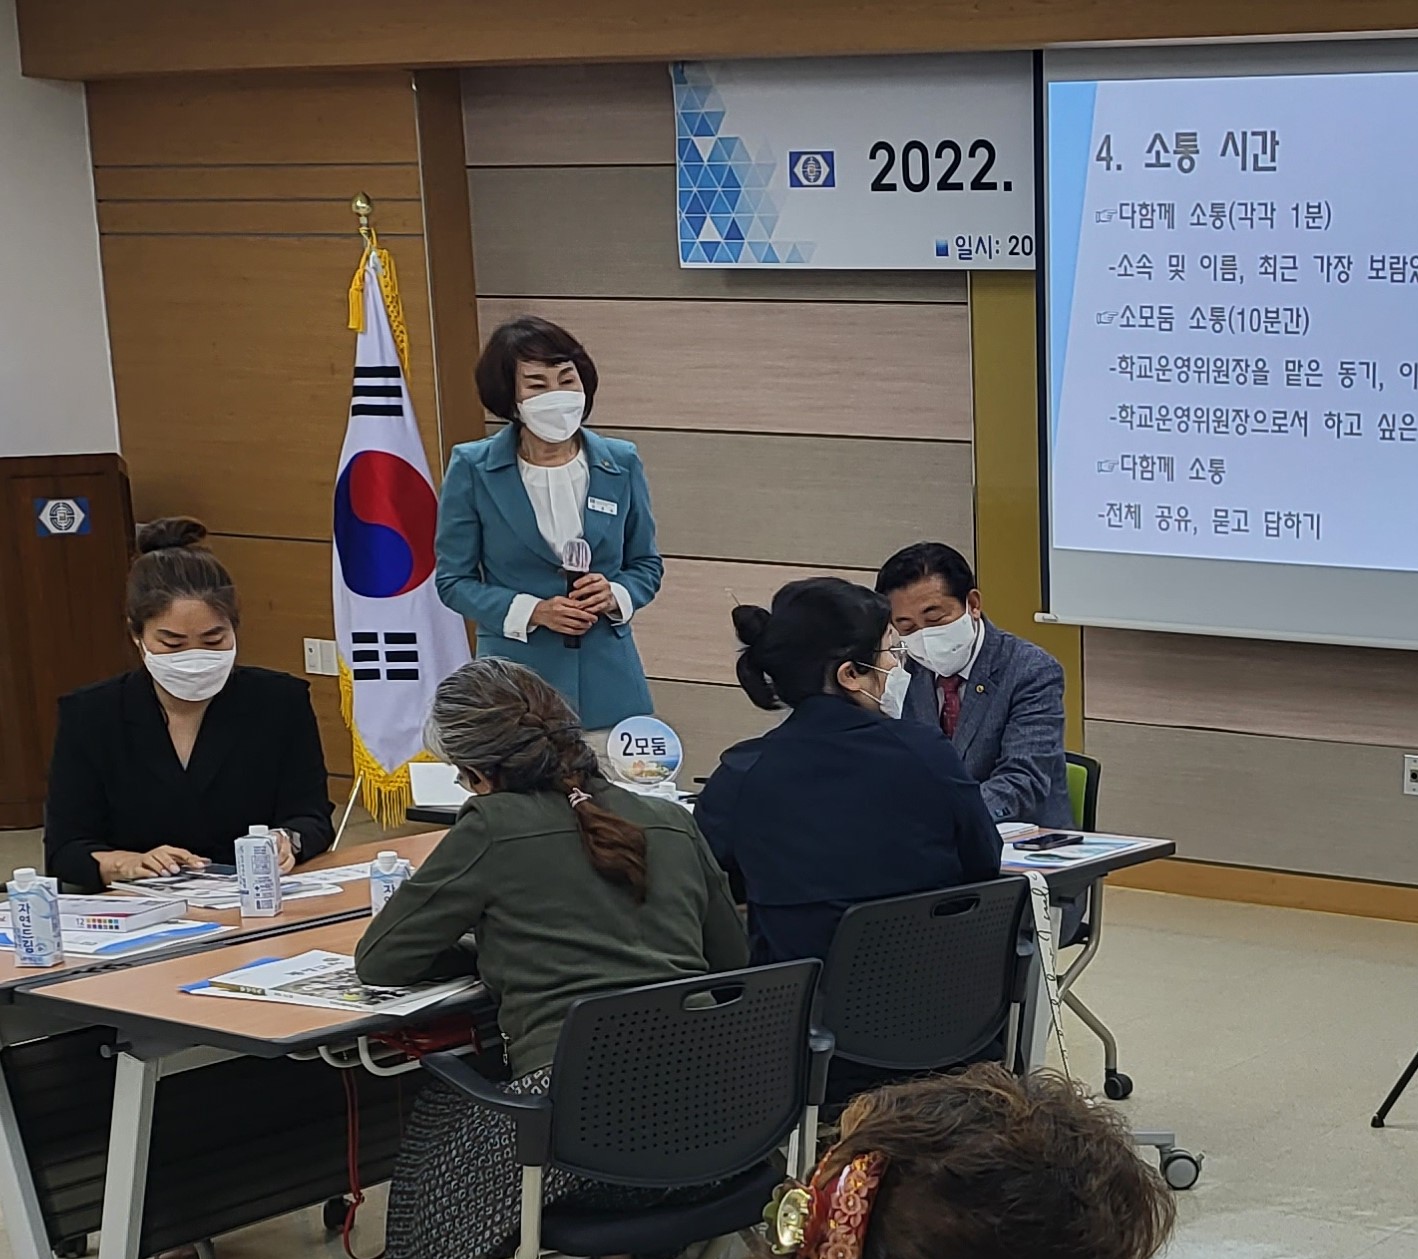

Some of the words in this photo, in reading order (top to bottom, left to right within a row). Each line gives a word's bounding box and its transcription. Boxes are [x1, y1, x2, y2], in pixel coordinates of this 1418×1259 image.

[870, 139, 1013, 193] 2022.
[1095, 134, 1122, 172] 4.
[1145, 132, 1199, 173] 소통
[1220, 130, 1279, 172] 시간
[1119, 203, 1175, 230] 다함께
[1189, 202, 1276, 231] 소통(각각
[1291, 202, 1332, 231] 1분)
[955, 235, 1001, 261] 일시:
[1007, 235, 1034, 256] 20
[1108, 254, 1153, 280] -소속
[1168, 254, 1185, 281] 및
[1200, 255, 1244, 284] 이름,
[1258, 255, 1298, 282] 최근
[1313, 255, 1352, 283] 가장
[1119, 306, 1174, 331] 소모둠
[1189, 306, 1310, 334] 소통(10분간)
[1110, 354, 1269, 385] -학교운영위원장을
[1285, 359, 1323, 387] 맡은
[1339, 361, 1384, 390] 동기,
[1110, 404, 1308, 437] -학교운영위원장으로서
[1324, 411, 1363, 438] 하고
[1378, 413, 1417, 441] 싶은
[1121, 455, 1174, 482] 다함께
[1189, 458, 1226, 484] 소통
[1099, 503, 1141, 529] -전체
[1155, 506, 1197, 534] 공유,
[1213, 508, 1249, 534] 묻고
[1264, 511, 1321, 539] 답하기
[621, 732, 666, 756] 2모둠
[18, 903, 34, 953] 자연드림
